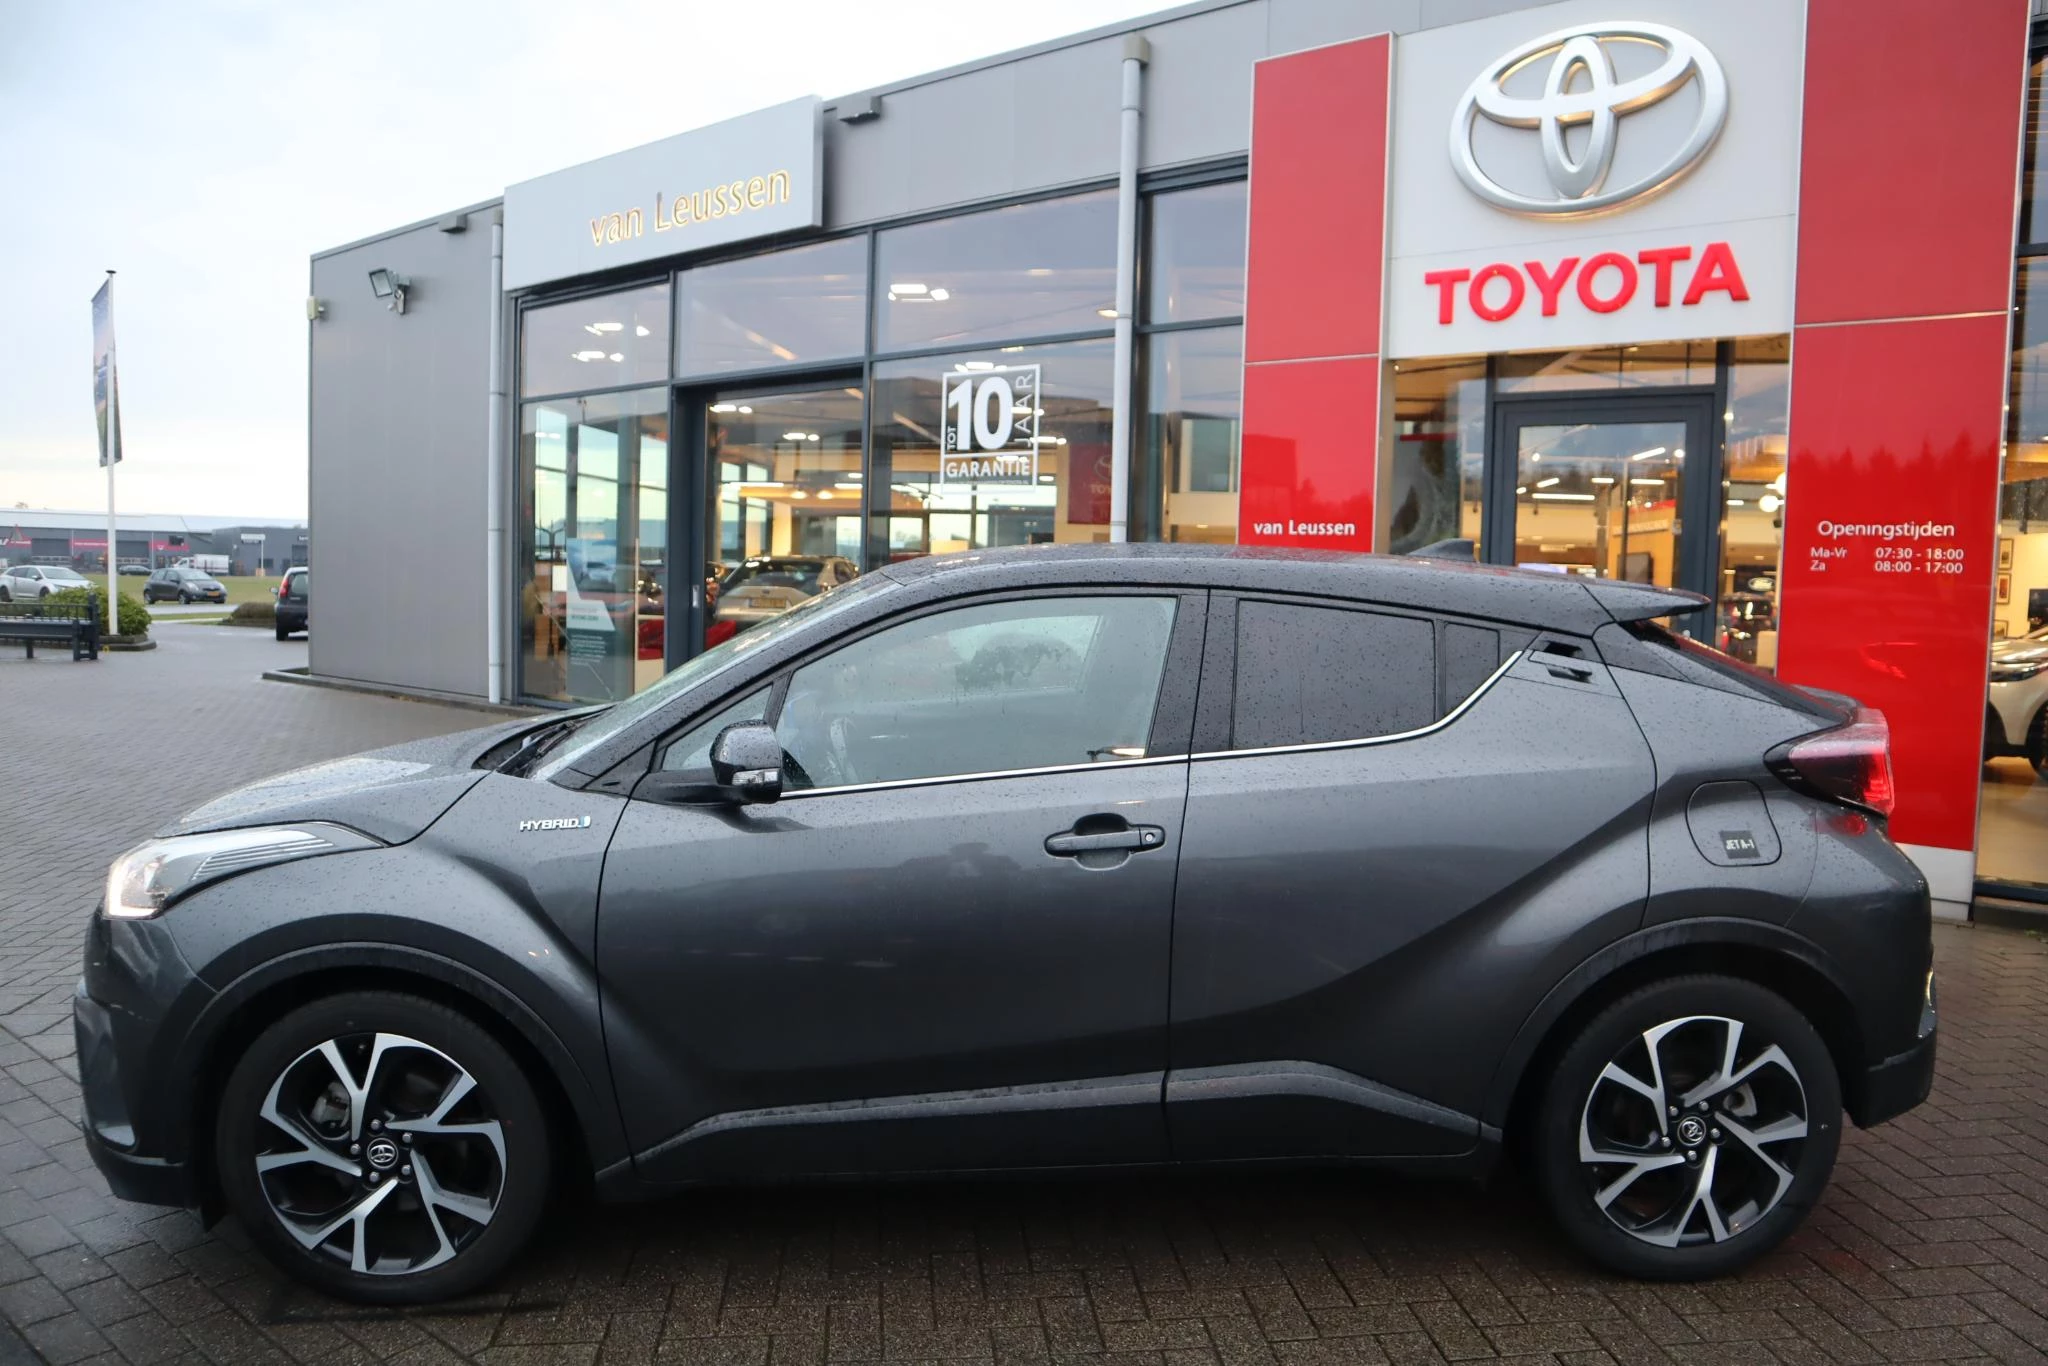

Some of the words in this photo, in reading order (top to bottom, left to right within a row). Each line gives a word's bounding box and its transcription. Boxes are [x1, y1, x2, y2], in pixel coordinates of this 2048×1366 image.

[591, 207, 643, 246] van
[655, 169, 790, 233] Leussen
[1424, 242, 1750, 325] TOYOTA
[948, 376, 1014, 450] 10
[1014, 373, 1033, 448] JAAR
[946, 426, 957, 451] TOT
[945, 457, 1031, 478] GARANTIE
[1253, 523, 1283, 535] van
[1288, 519, 1356, 536] Leussen
[1817, 520, 1955, 541] Openingstijden
[1810, 547, 1847, 558] Ma-Vr
[1875, 548, 1913, 559] 07:30
[1926, 549, 1964, 560] 18:00
[1810, 560, 1826, 571] Za
[1874, 561, 1912, 572] 08:00
[1925, 562, 1963, 574] 17:00
[520, 818, 579, 831] HYBRID
